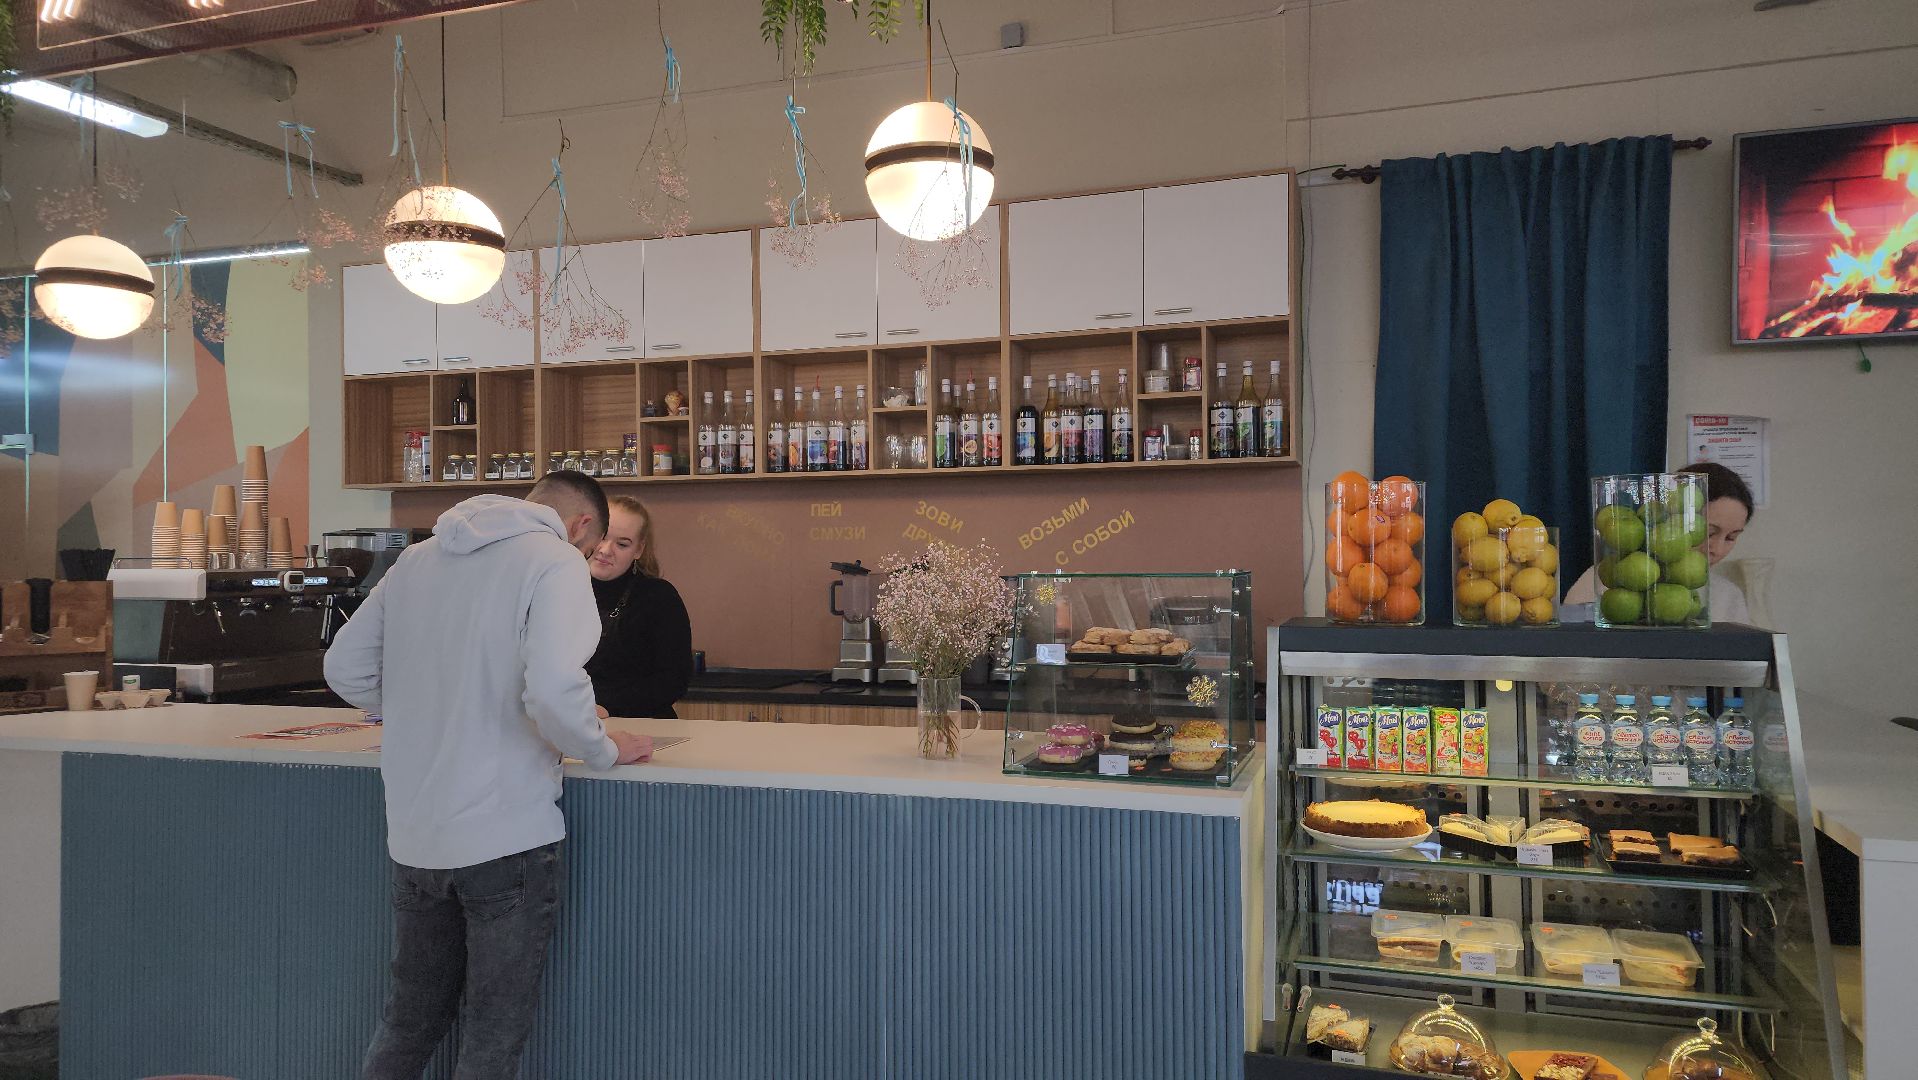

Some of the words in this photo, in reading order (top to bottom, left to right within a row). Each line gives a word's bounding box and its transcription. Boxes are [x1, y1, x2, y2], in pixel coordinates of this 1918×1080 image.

[810, 501, 842, 517] ПЕЙ
[915, 500, 964, 534] ЗОВИ
[1018, 496, 1091, 550] ВОЗЬМИ
[810, 526, 866, 541] СМУЗИ
[1055, 550, 1070, 566] С
[1072, 509, 1136, 555] СОБОЙ
